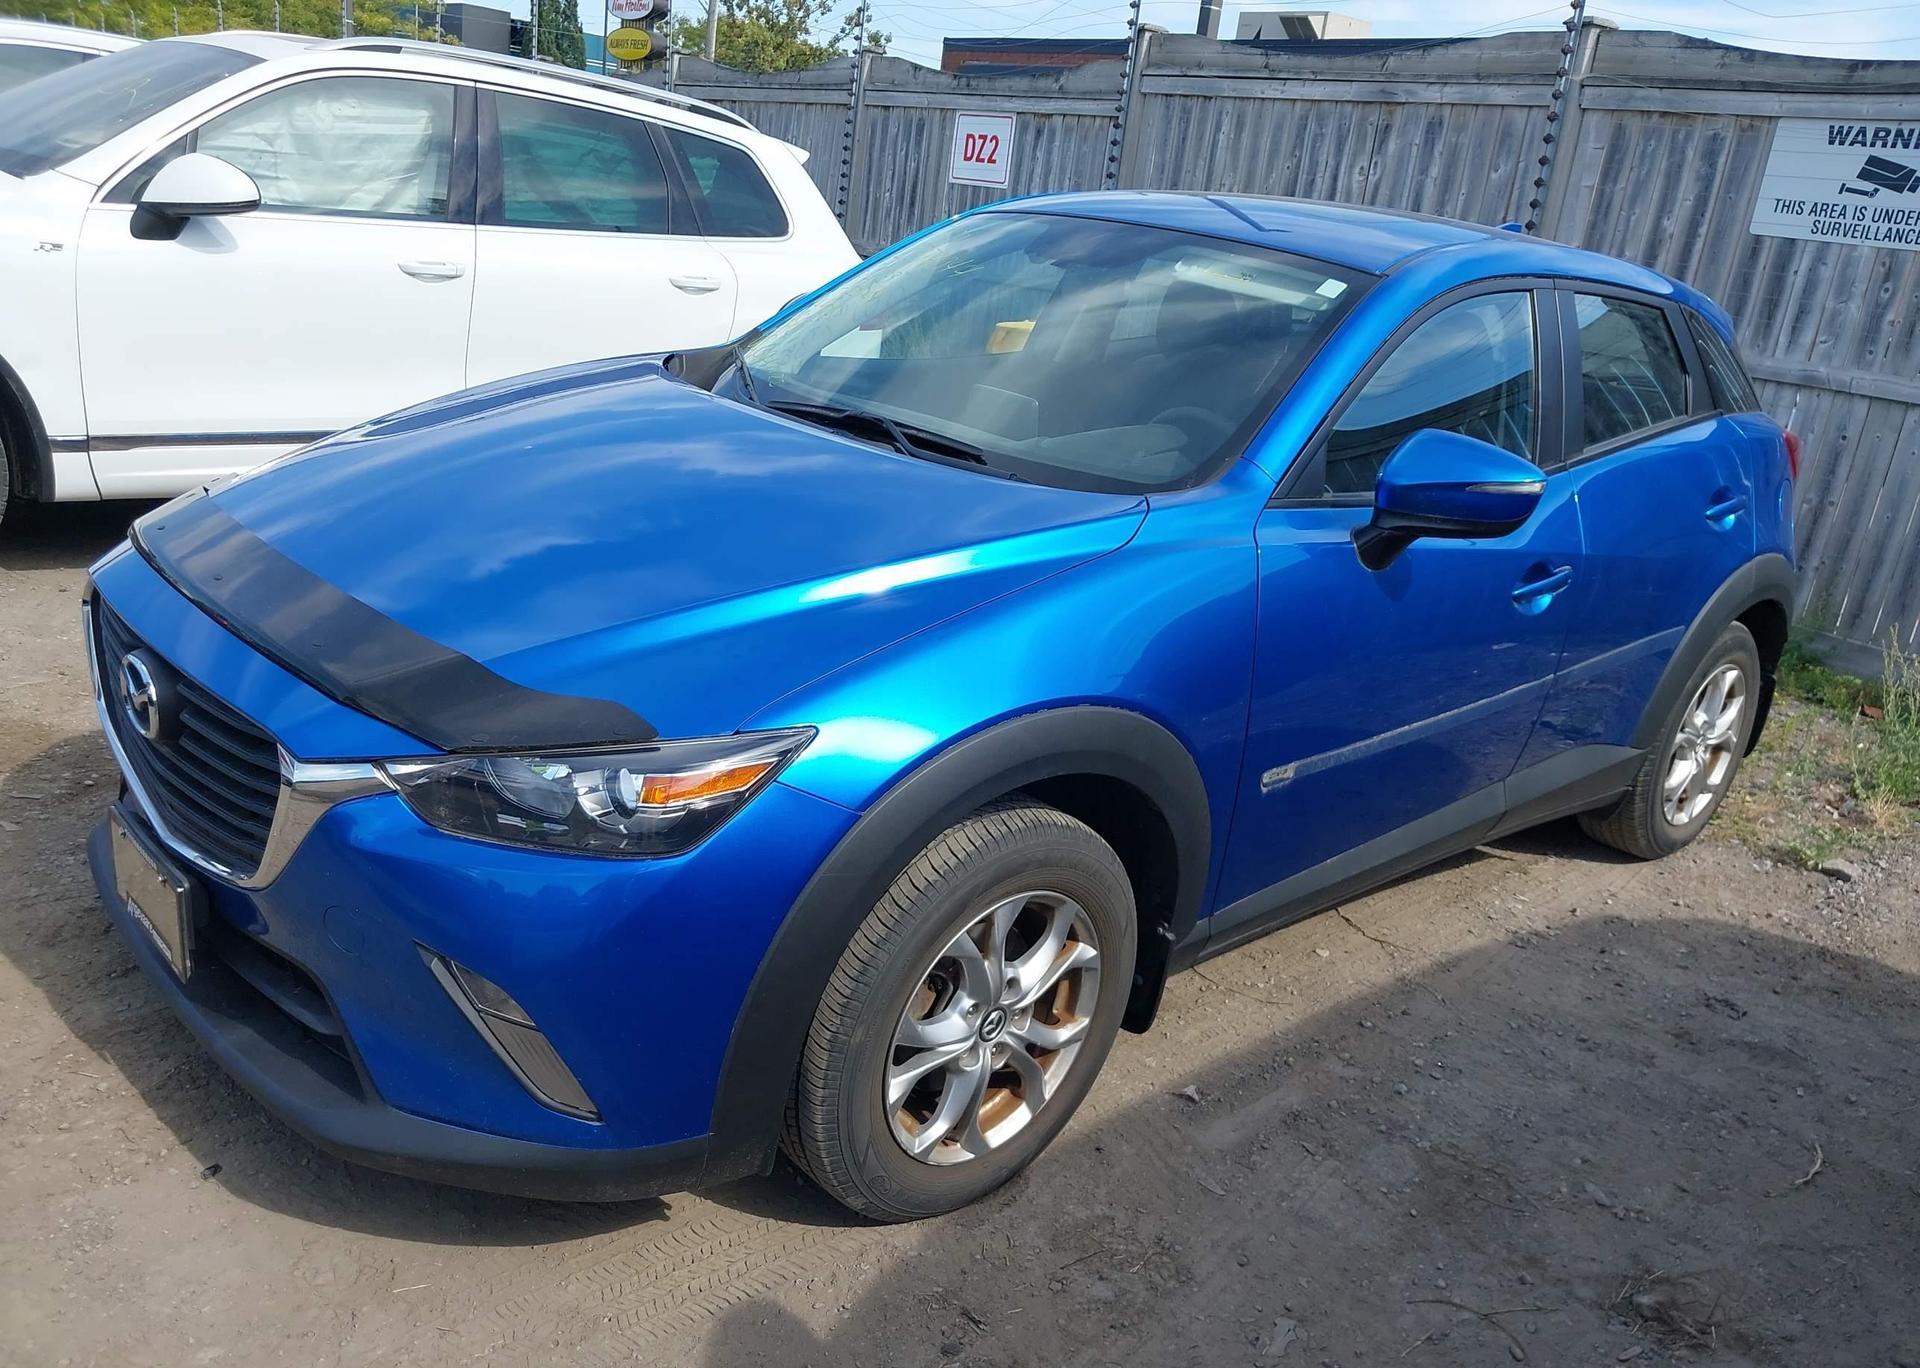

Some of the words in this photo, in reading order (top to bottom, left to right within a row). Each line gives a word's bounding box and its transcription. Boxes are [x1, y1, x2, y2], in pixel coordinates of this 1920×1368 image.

[609, 38, 629, 48] ALWAYS
[629, 39, 649, 50] FRESH
[963, 133, 1000, 165] DZ2
[1773, 198, 1806, 216] THIS
[1808, 202, 1848, 220] AREA
[1852, 205, 1868, 222] IS
